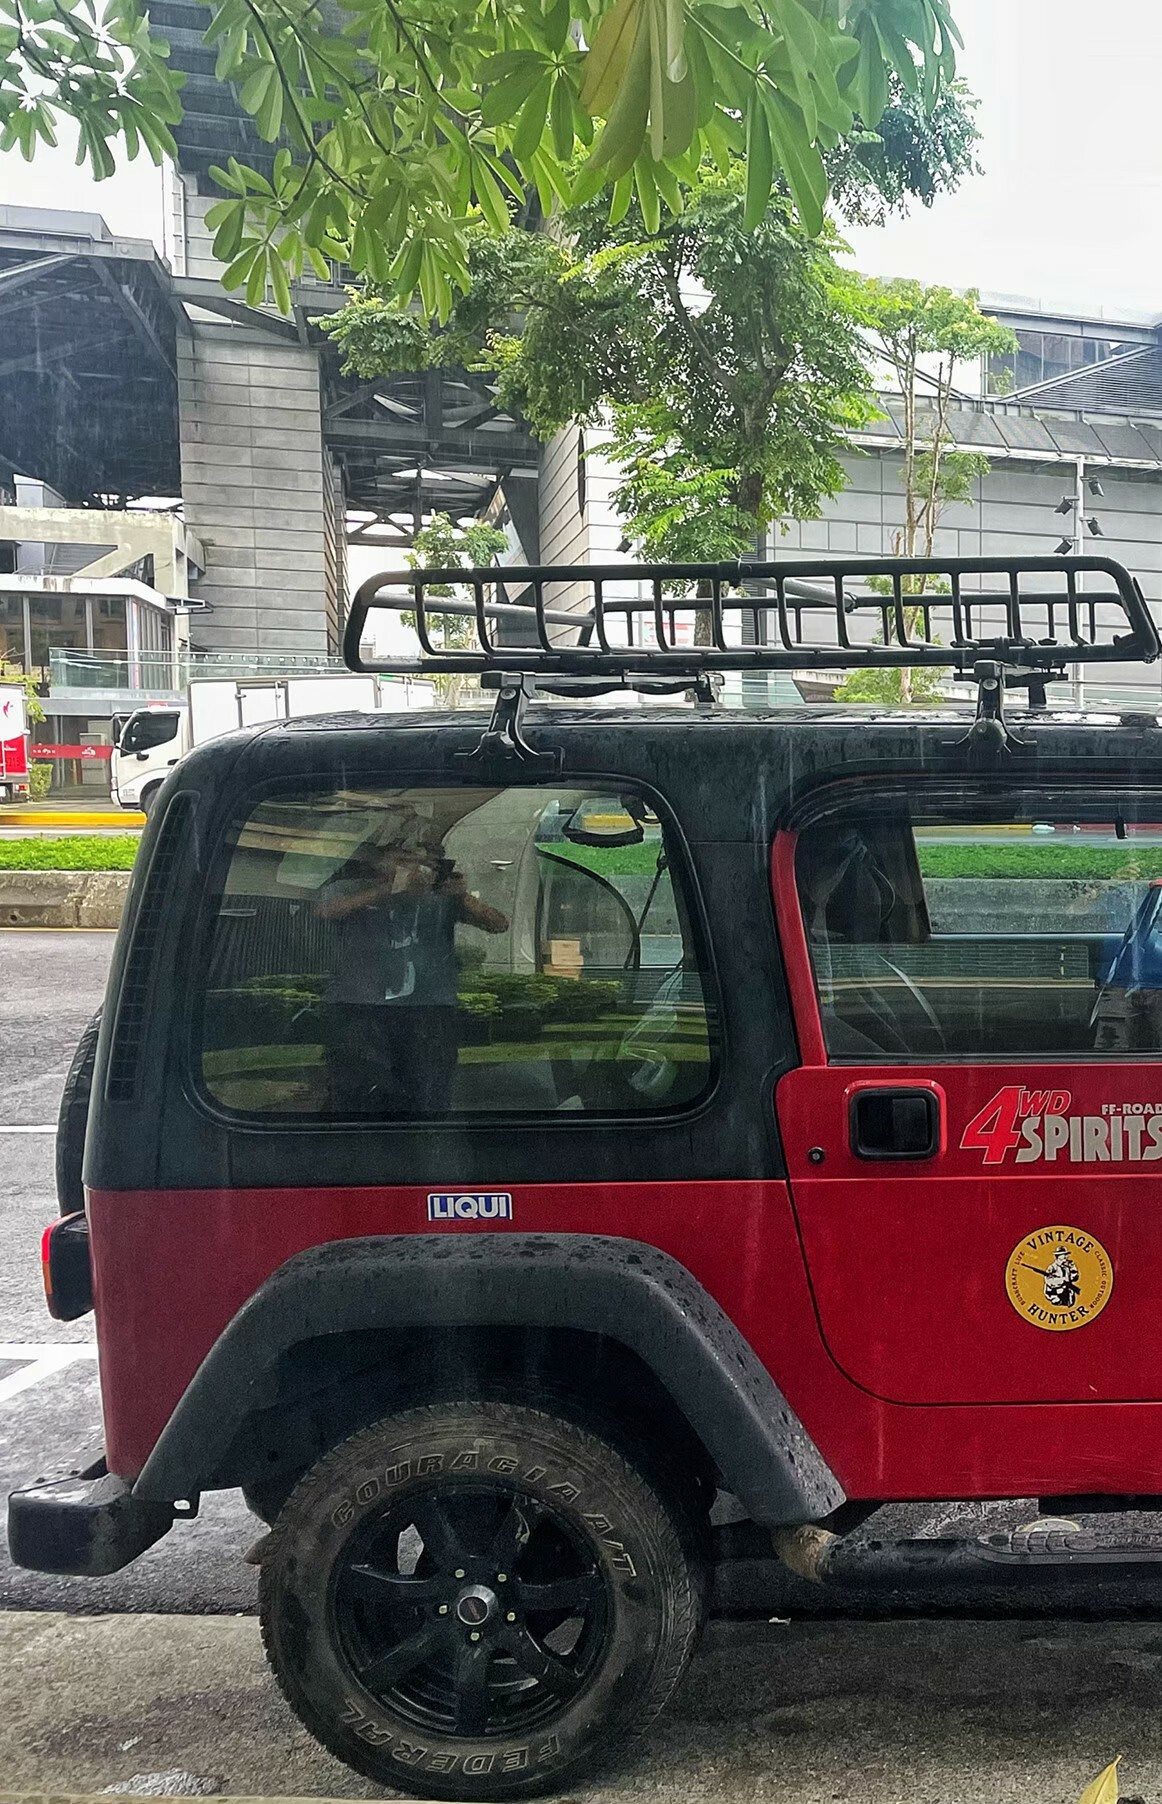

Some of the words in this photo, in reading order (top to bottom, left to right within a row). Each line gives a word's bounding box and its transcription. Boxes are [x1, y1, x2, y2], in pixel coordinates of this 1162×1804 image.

[433, 1196, 507, 1219] LIQUI
[1026, 1230, 1094, 1254] VINTAGE
[1094, 1250, 1107, 1277] CLASSIC
[1027, 1303, 1089, 1325] HUNTER
[331, 1451, 581, 1528] COURAGIA
[583, 1513, 637, 1577] A/T
[340, 1699, 563, 1775] FEDERAL
